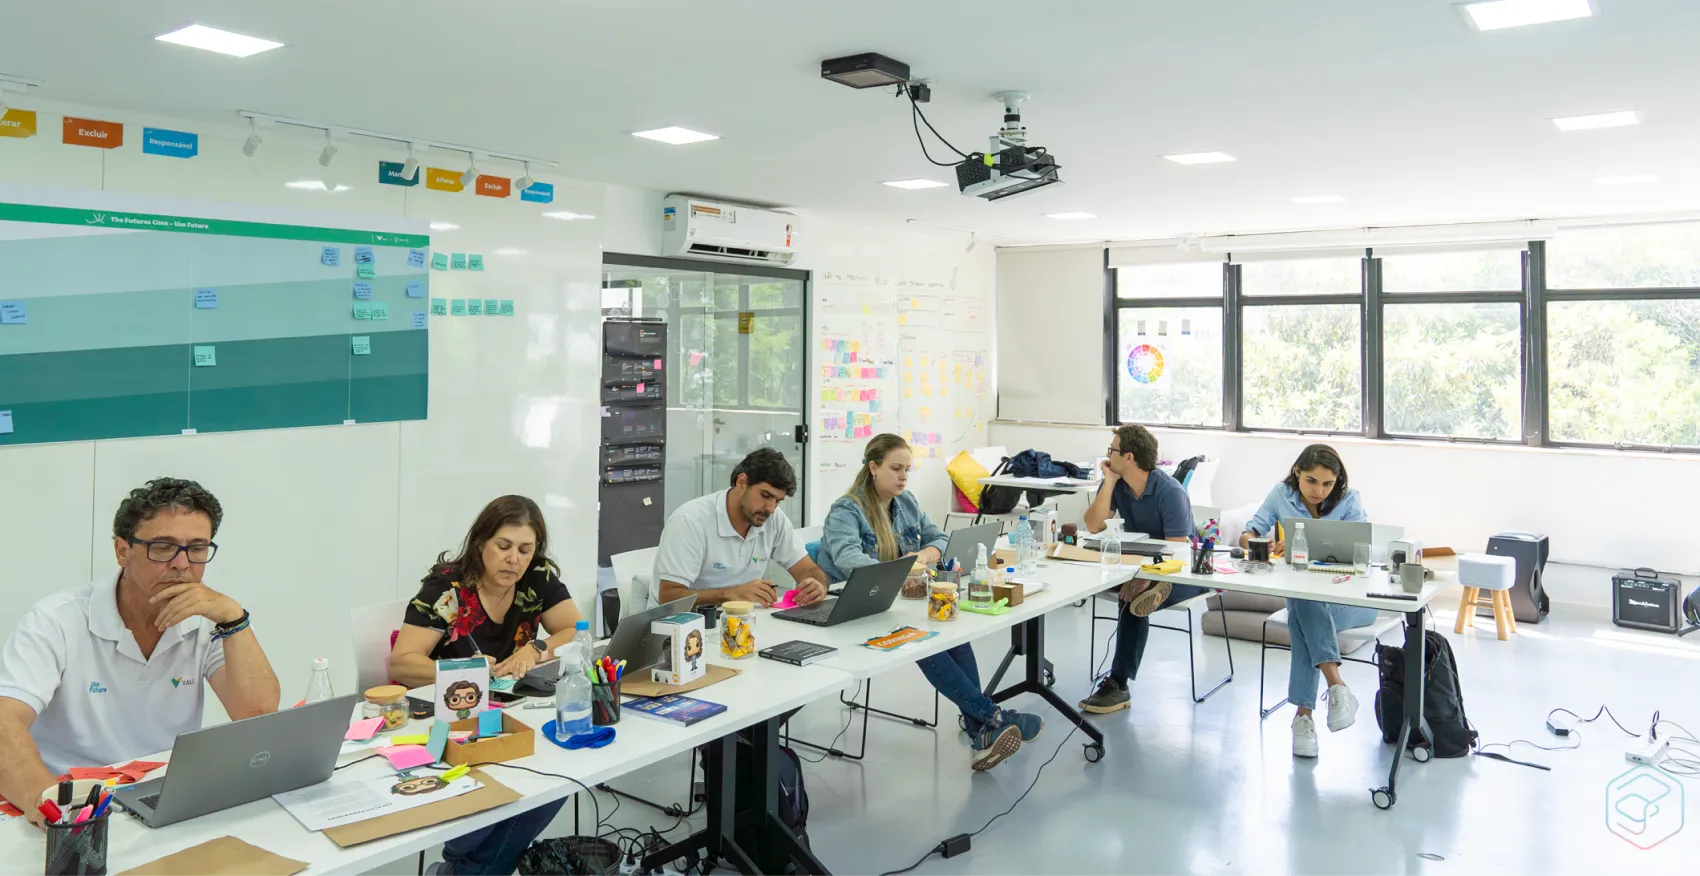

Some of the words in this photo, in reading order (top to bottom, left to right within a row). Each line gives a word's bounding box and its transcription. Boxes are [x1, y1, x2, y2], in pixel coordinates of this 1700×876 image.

[78, 128, 108, 139] Excluir
[149, 137, 193, 150] Responsável
[435, 177, 455, 185] Alterar
[484, 182, 502, 191] Excluir
[110, 216, 123, 224] The
